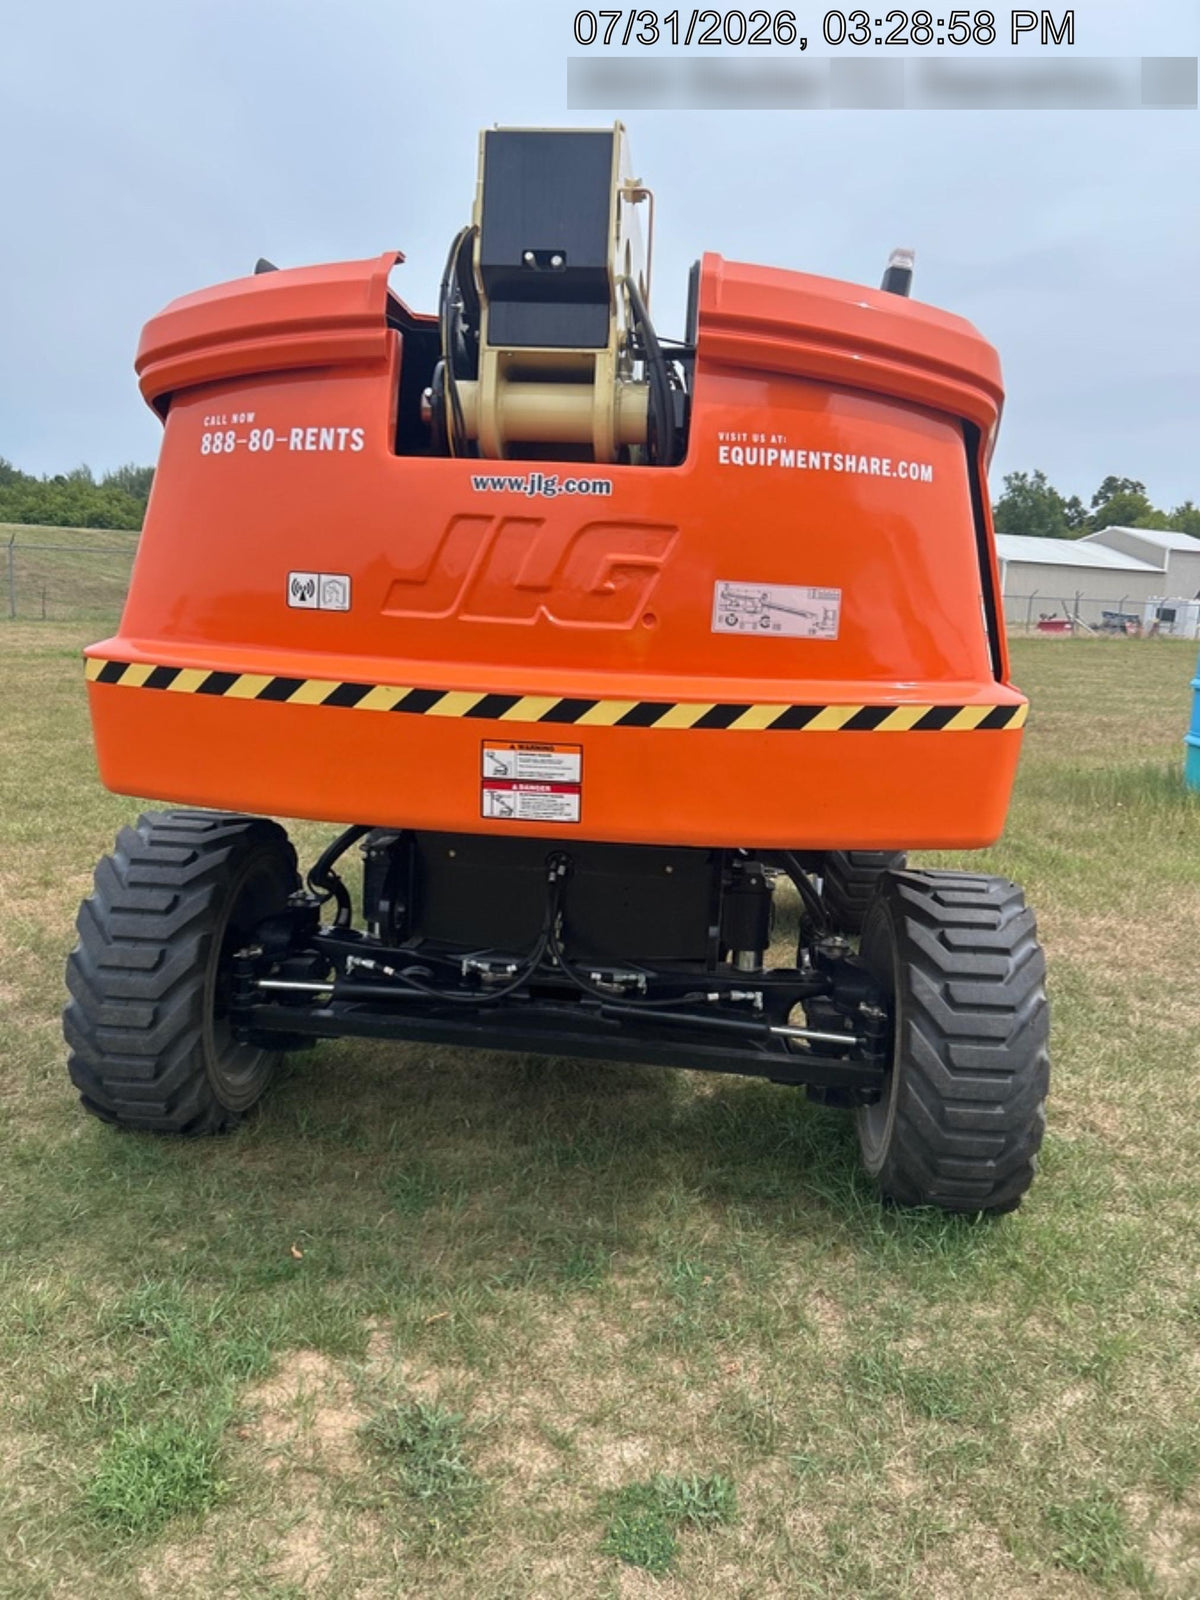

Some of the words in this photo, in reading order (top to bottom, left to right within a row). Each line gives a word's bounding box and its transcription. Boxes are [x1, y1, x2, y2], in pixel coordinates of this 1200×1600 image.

[204, 415, 227, 426] CALL
[231, 412, 255, 424] NOW
[201, 427, 365, 455] 888-80-RENTS
[718, 432, 747, 442] VISIT
[752, 434, 766, 443] US
[770, 435, 787, 444] AT:
[718, 445, 933, 483] EQUIPMENTSHARE.COM
[471, 472, 612, 497] www.jlg.com
[380, 513, 680, 630] JLG
[518, 744, 555, 752] WARNING
[519, 784, 552, 792] DANGER
